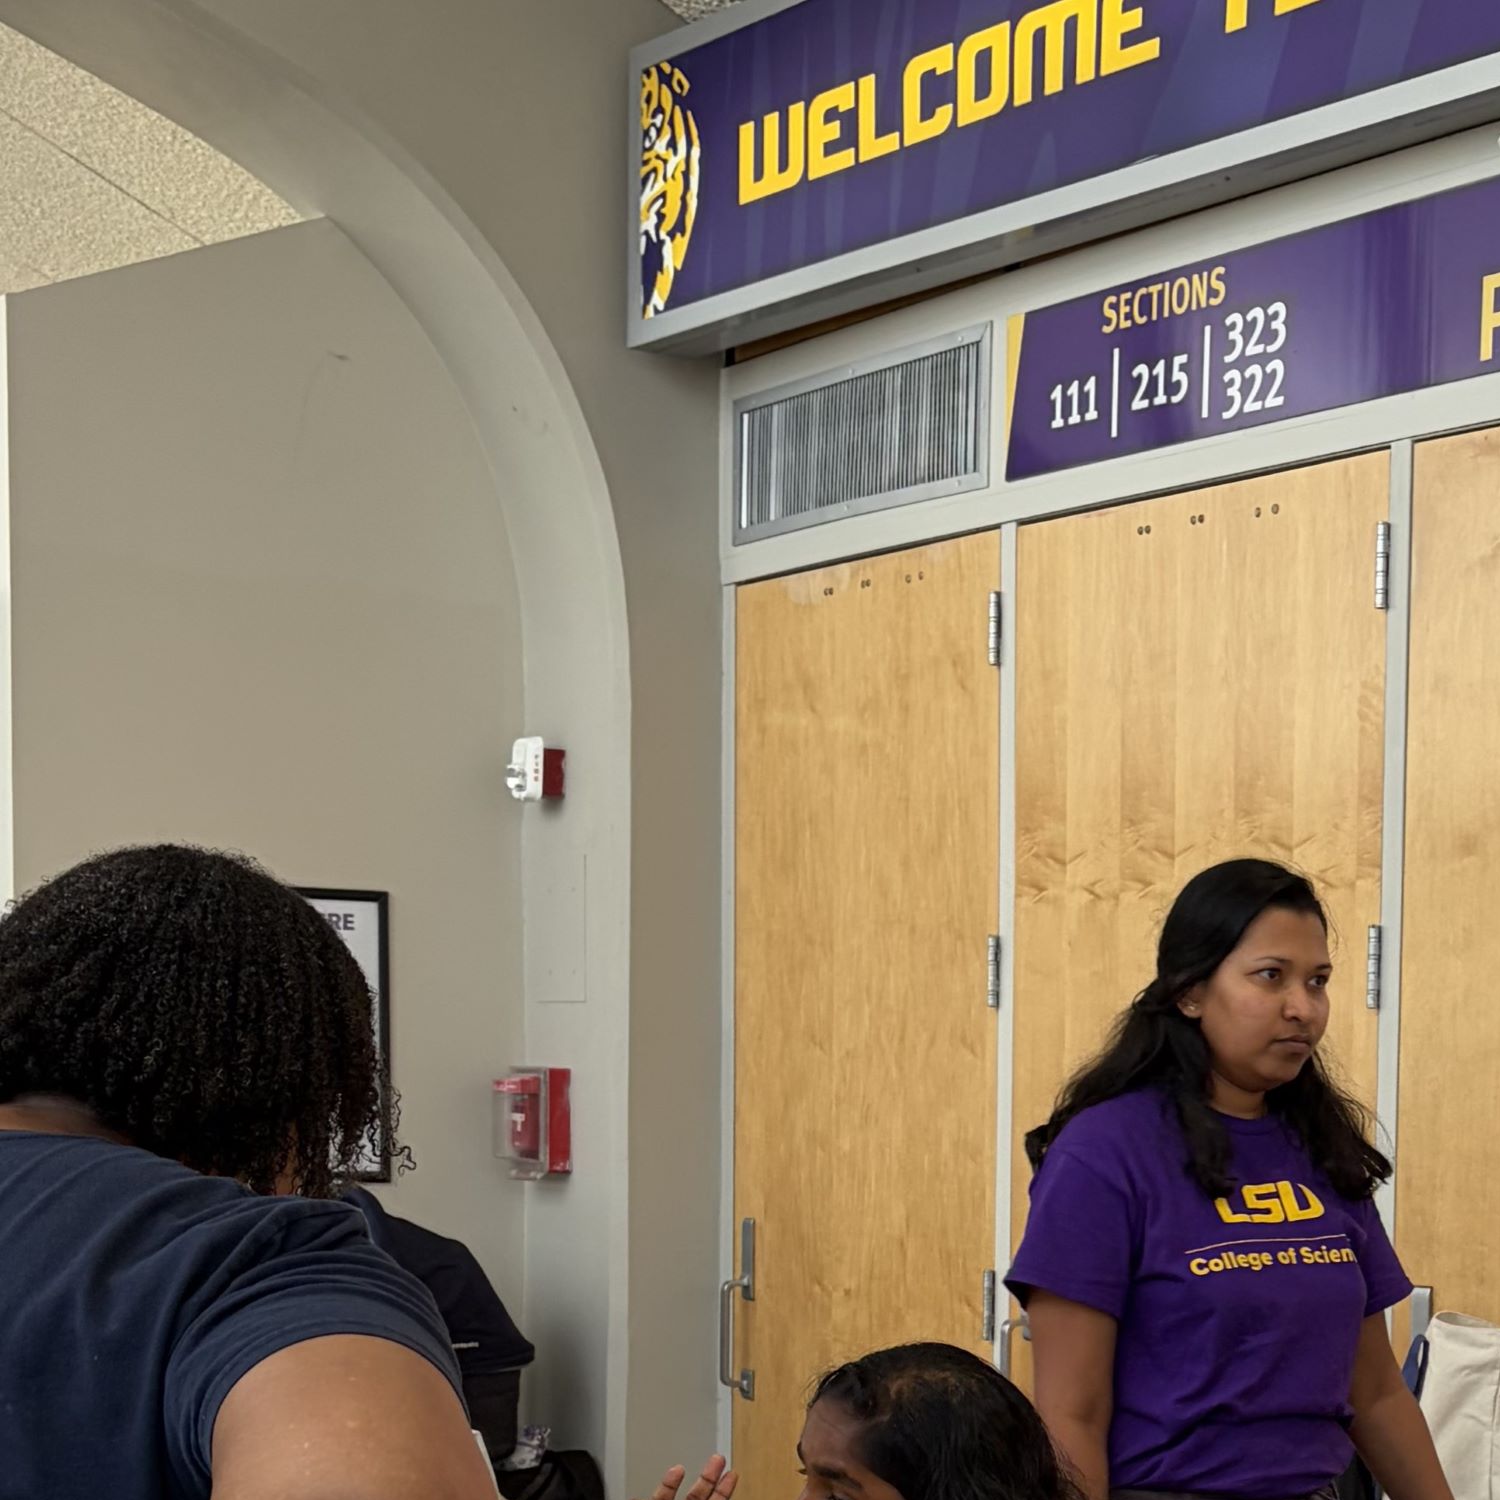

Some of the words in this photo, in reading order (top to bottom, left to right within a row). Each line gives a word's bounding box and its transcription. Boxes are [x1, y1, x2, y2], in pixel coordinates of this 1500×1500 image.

[738, 0, 1160, 206] WELCOME
[1102, 266, 1226, 334] SECTIONS
[1223, 300, 1286, 363] 323
[1050, 375, 1099, 430] 111
[1130, 353, 1188, 411] 215
[1221, 358, 1285, 420] 322
[1214, 1180, 1325, 1223] LSU
[1190, 1250, 1273, 1276] College
[1276, 1247, 1298, 1265] of
[1299, 1245, 1358, 1264] Scien
